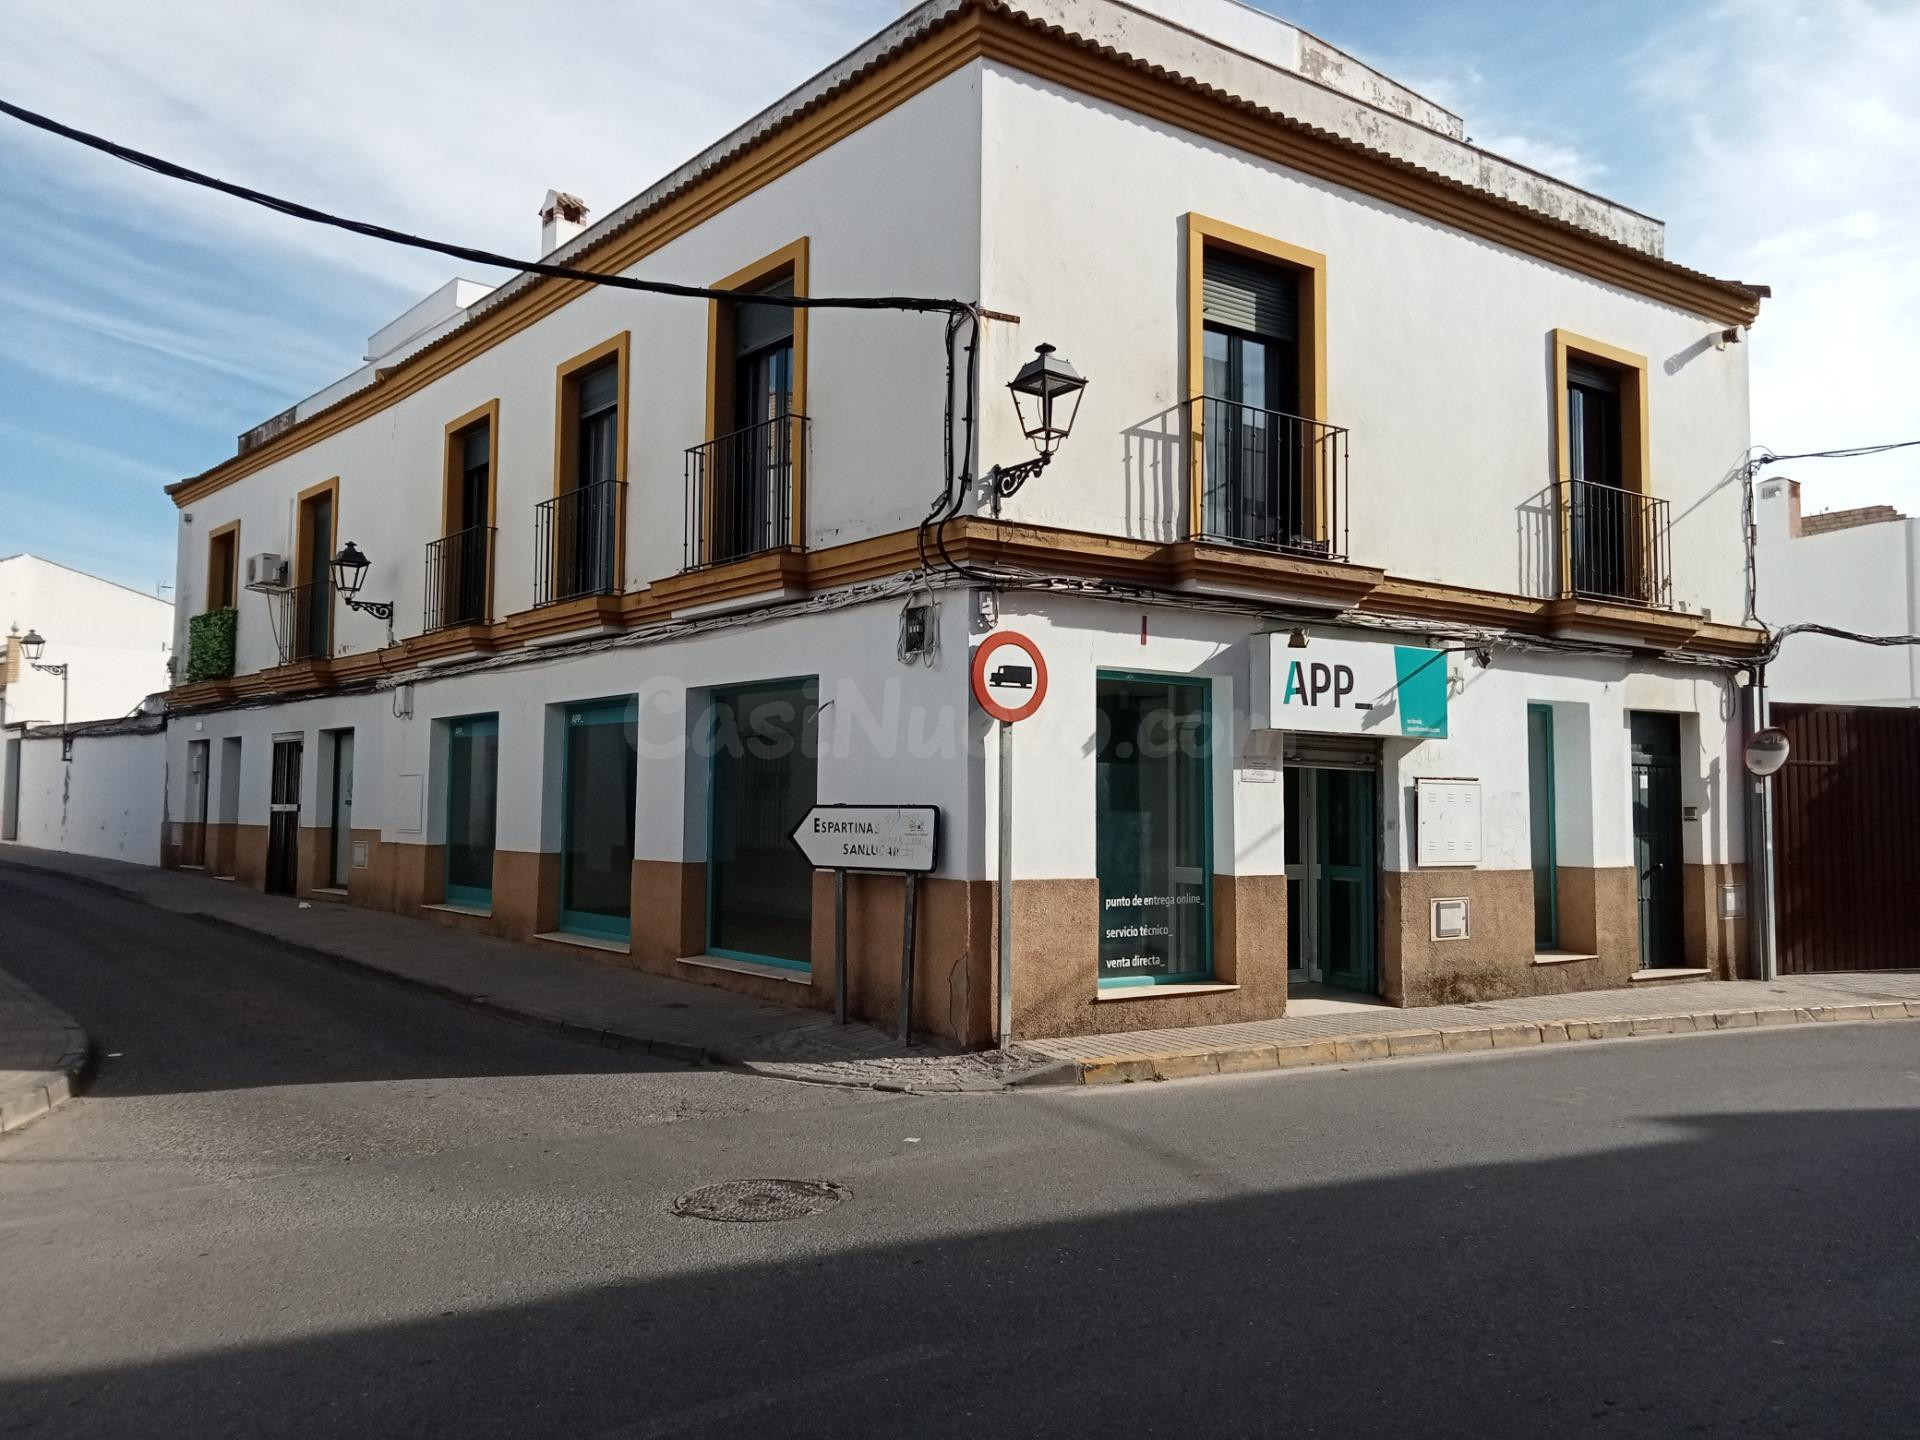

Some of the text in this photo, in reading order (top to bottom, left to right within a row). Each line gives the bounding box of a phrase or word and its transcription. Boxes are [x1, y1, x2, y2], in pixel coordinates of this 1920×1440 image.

[1105, 896, 1131, 911] punto
[1131, 894, 1142, 907] de
[1143, 895, 1175, 908] entrega
[1105, 925, 1139, 939] servicio
[1105, 956, 1131, 969] venta
